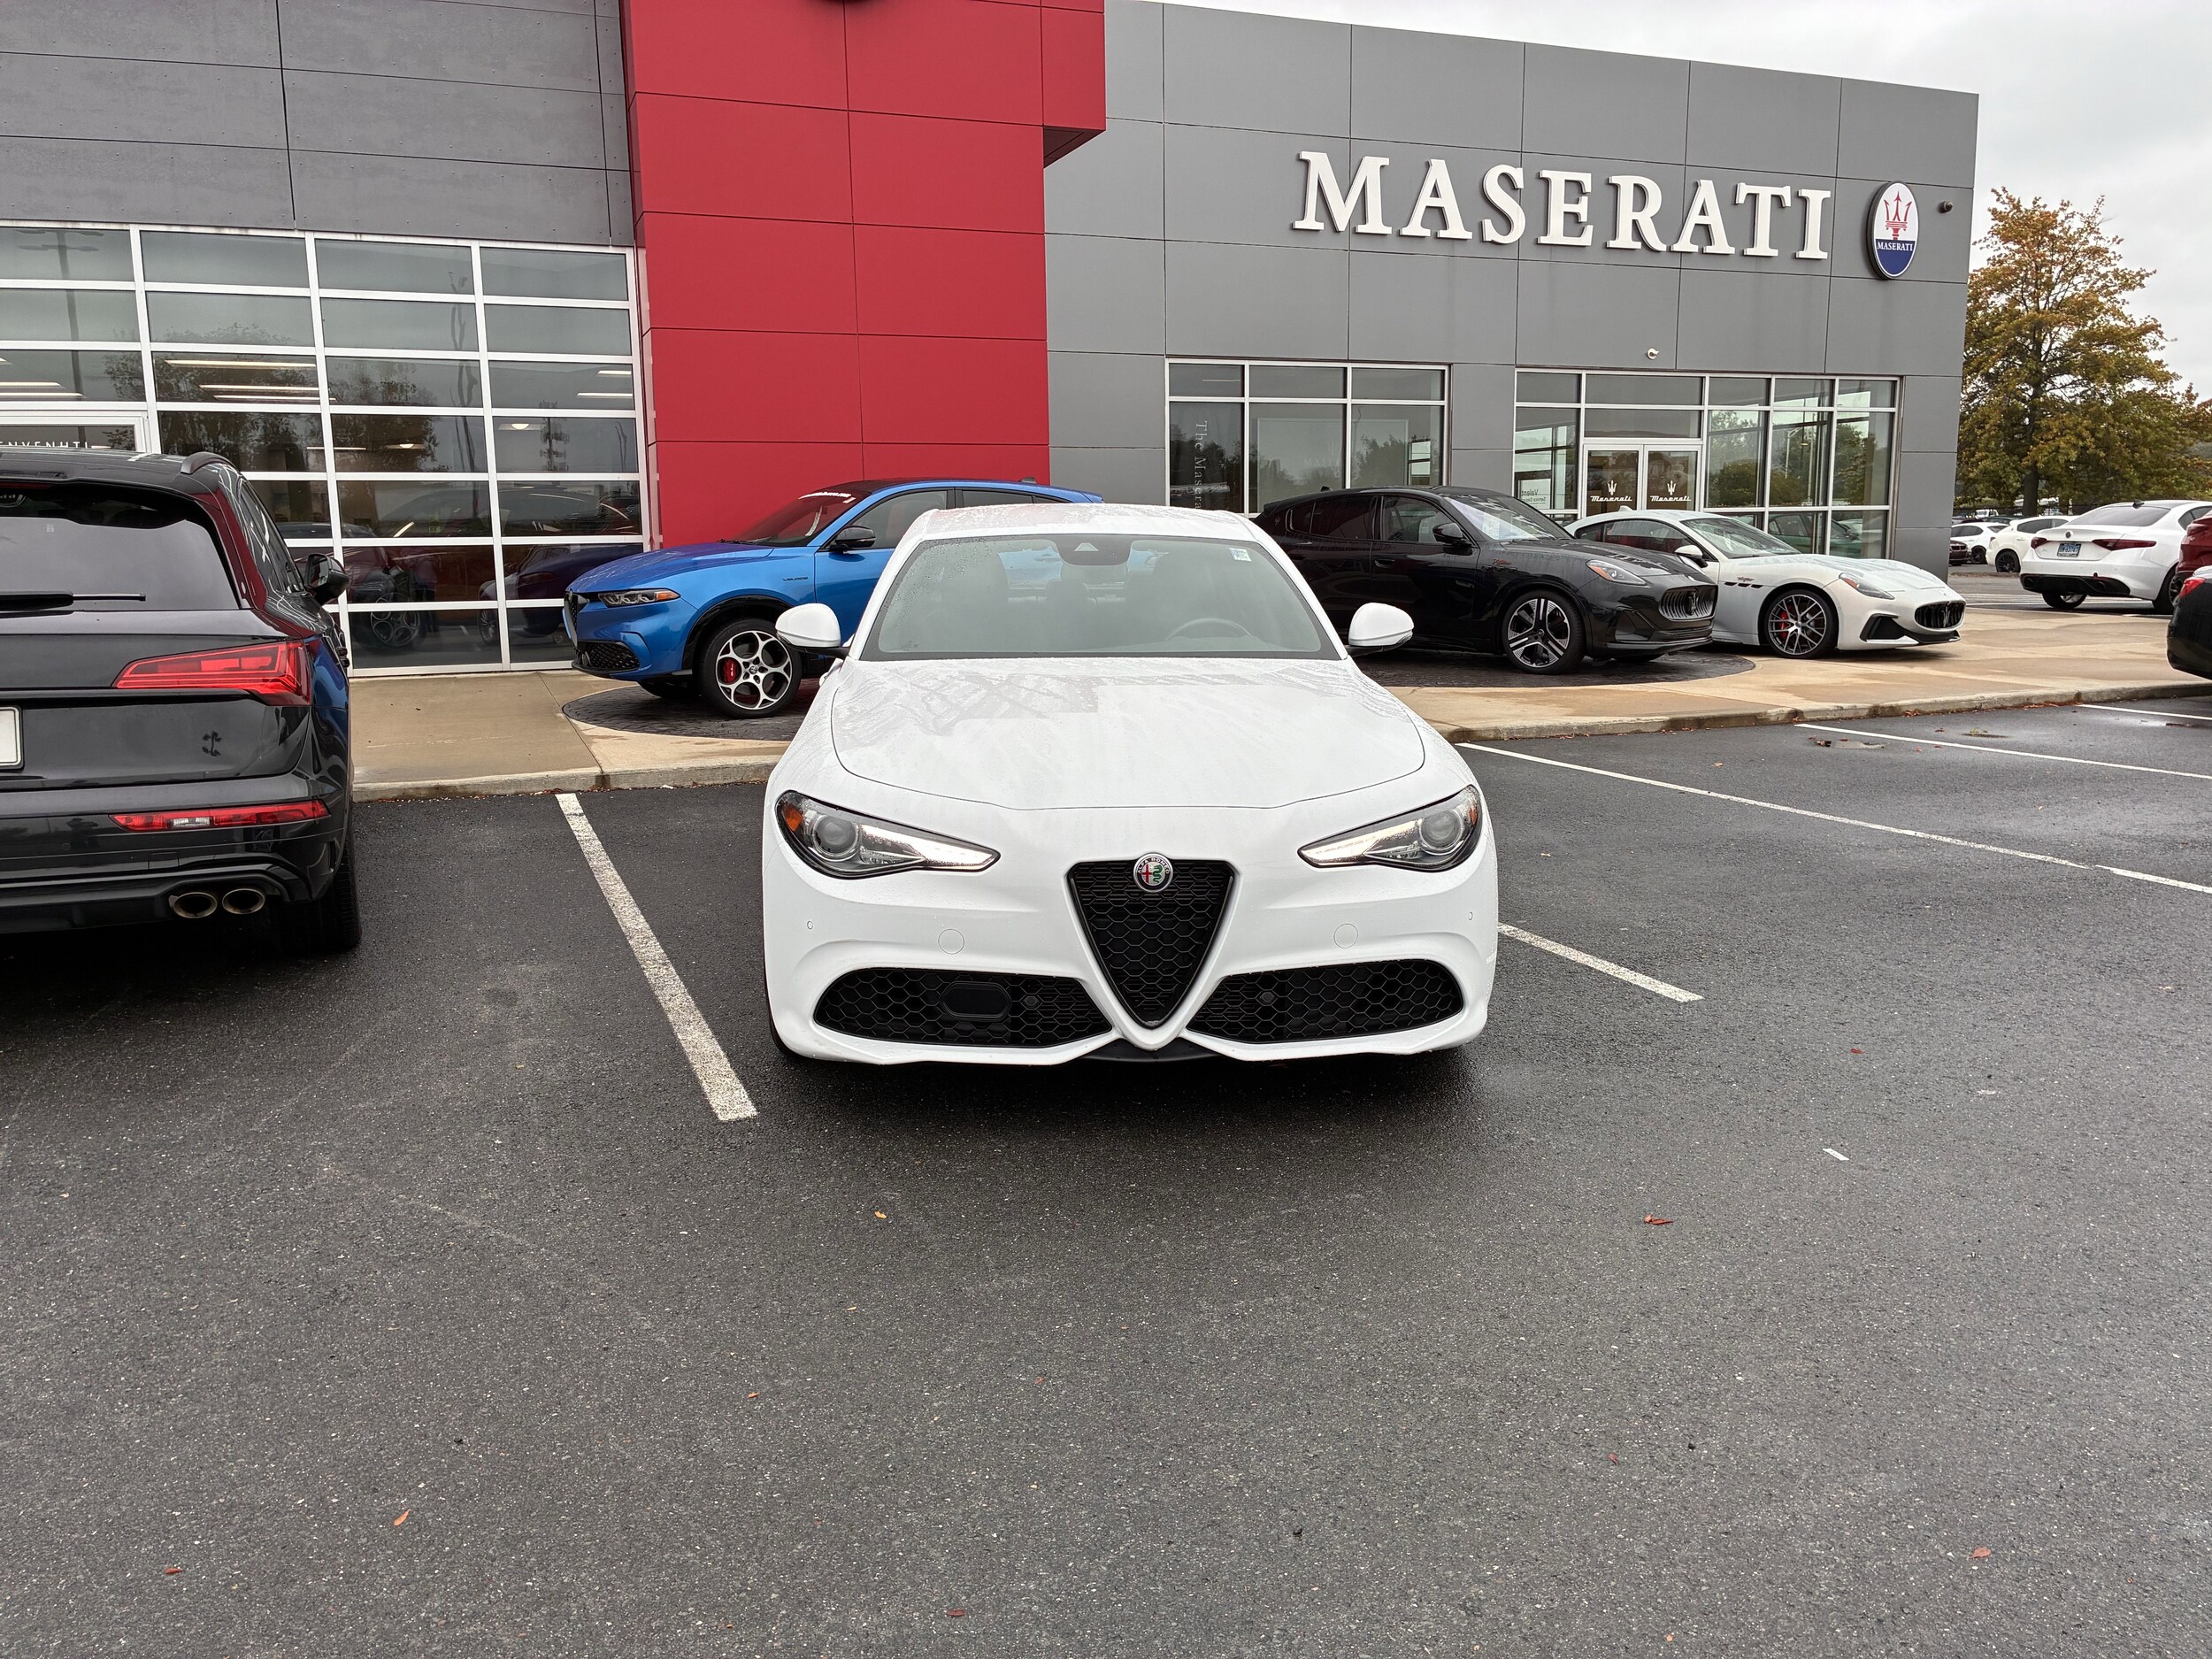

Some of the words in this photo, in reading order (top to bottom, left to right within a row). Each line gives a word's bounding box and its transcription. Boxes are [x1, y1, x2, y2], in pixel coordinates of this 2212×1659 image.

[1292, 150, 1832, 260] MASERATI
[1877, 242, 1914, 252] MASERATI
[1195, 420, 1208, 449] The
